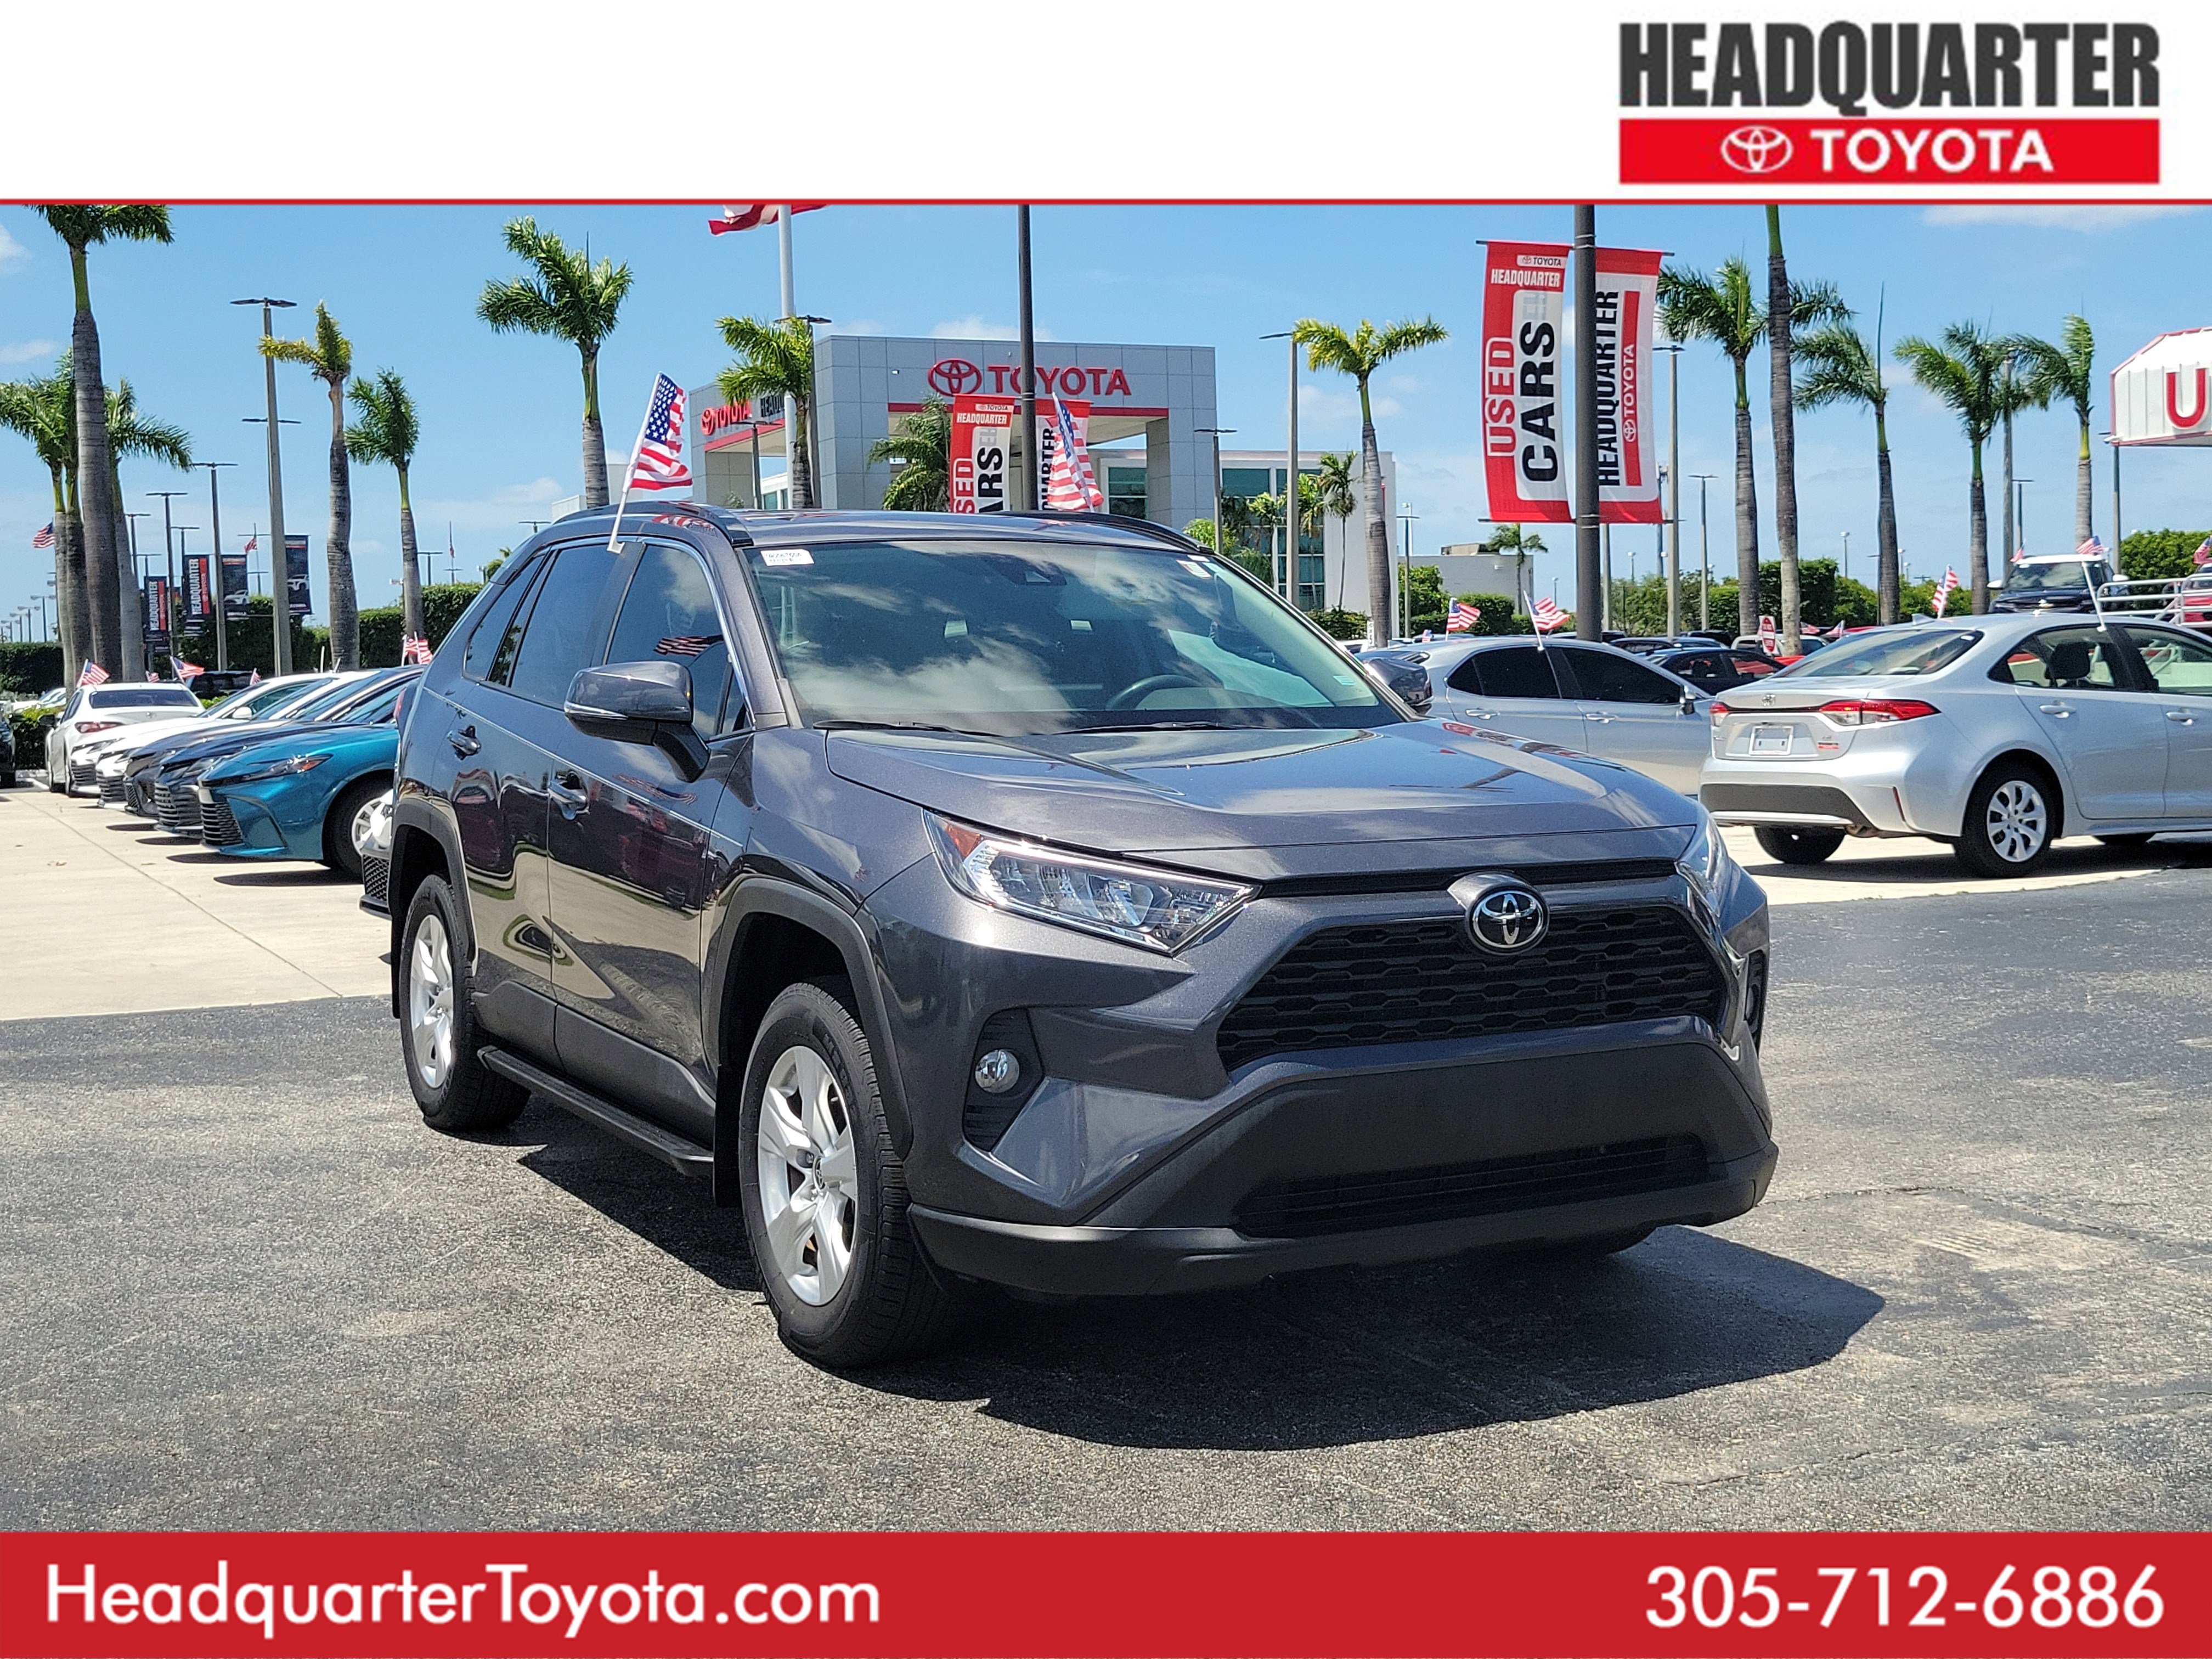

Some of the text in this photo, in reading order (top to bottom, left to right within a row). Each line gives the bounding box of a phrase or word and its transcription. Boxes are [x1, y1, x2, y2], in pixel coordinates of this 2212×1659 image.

[1491, 269, 1560, 288] HEADQUARTER
[1533, 257, 1561, 266] TOYOTA
[1488, 338, 1516, 456] USED
[1520, 321, 1558, 482] CARS
[1623, 344, 1634, 417] TOYOTA
[956, 413, 1007, 425] HEADQUARTER
[955, 460, 975, 514] SED
[977, 447, 1003, 513] ARS
